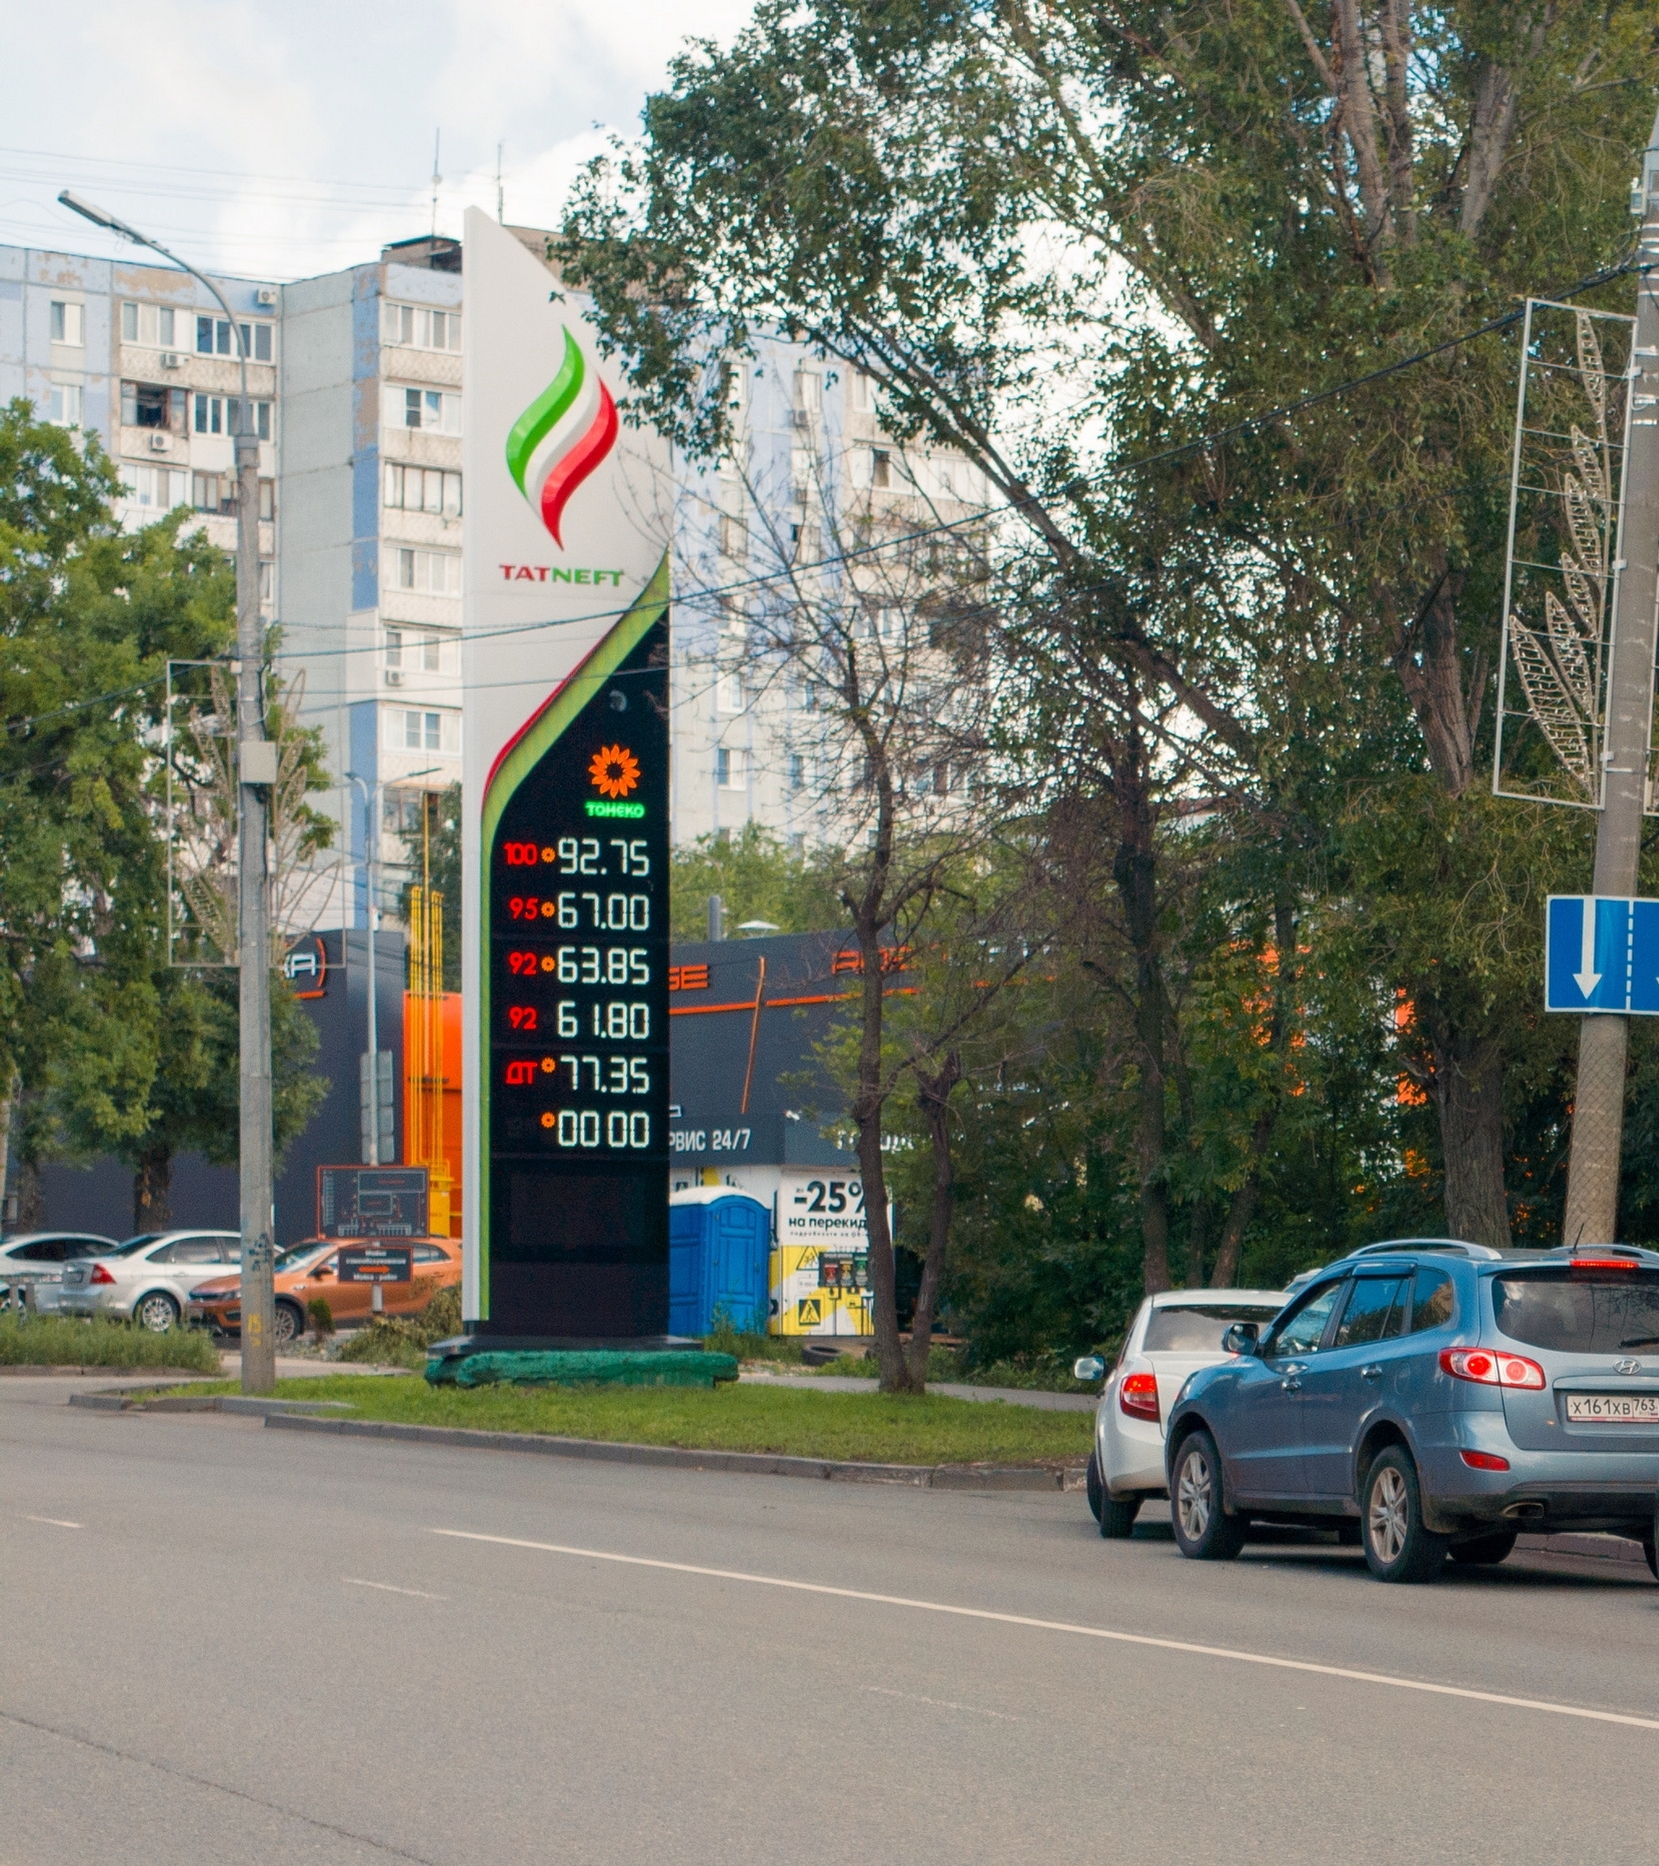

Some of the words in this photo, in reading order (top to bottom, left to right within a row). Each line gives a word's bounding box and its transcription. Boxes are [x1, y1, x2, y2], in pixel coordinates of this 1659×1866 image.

[499, 564, 624, 587] TATNEFT
[504, 842, 538, 866] 100
[558, 837, 650, 876] 92.75
[509, 897, 538, 920] 95
[558, 892, 650, 931] 67.00
[509, 952, 538, 976] 92
[558, 946, 650, 985] 63.85
[509, 1006, 538, 1030] 92
[558, 1000, 650, 1040] 61.80
[506, 1060, 538, 1085] ДТ
[560, 1055, 650, 1094] 77.35
[712, 1128, 751, 1151] 24/7
[788, 1218, 806, 1228] на
[1573, 1399, 1631, 1415] Х161ХВ
[1633, 1399, 1656, 1411] 763
